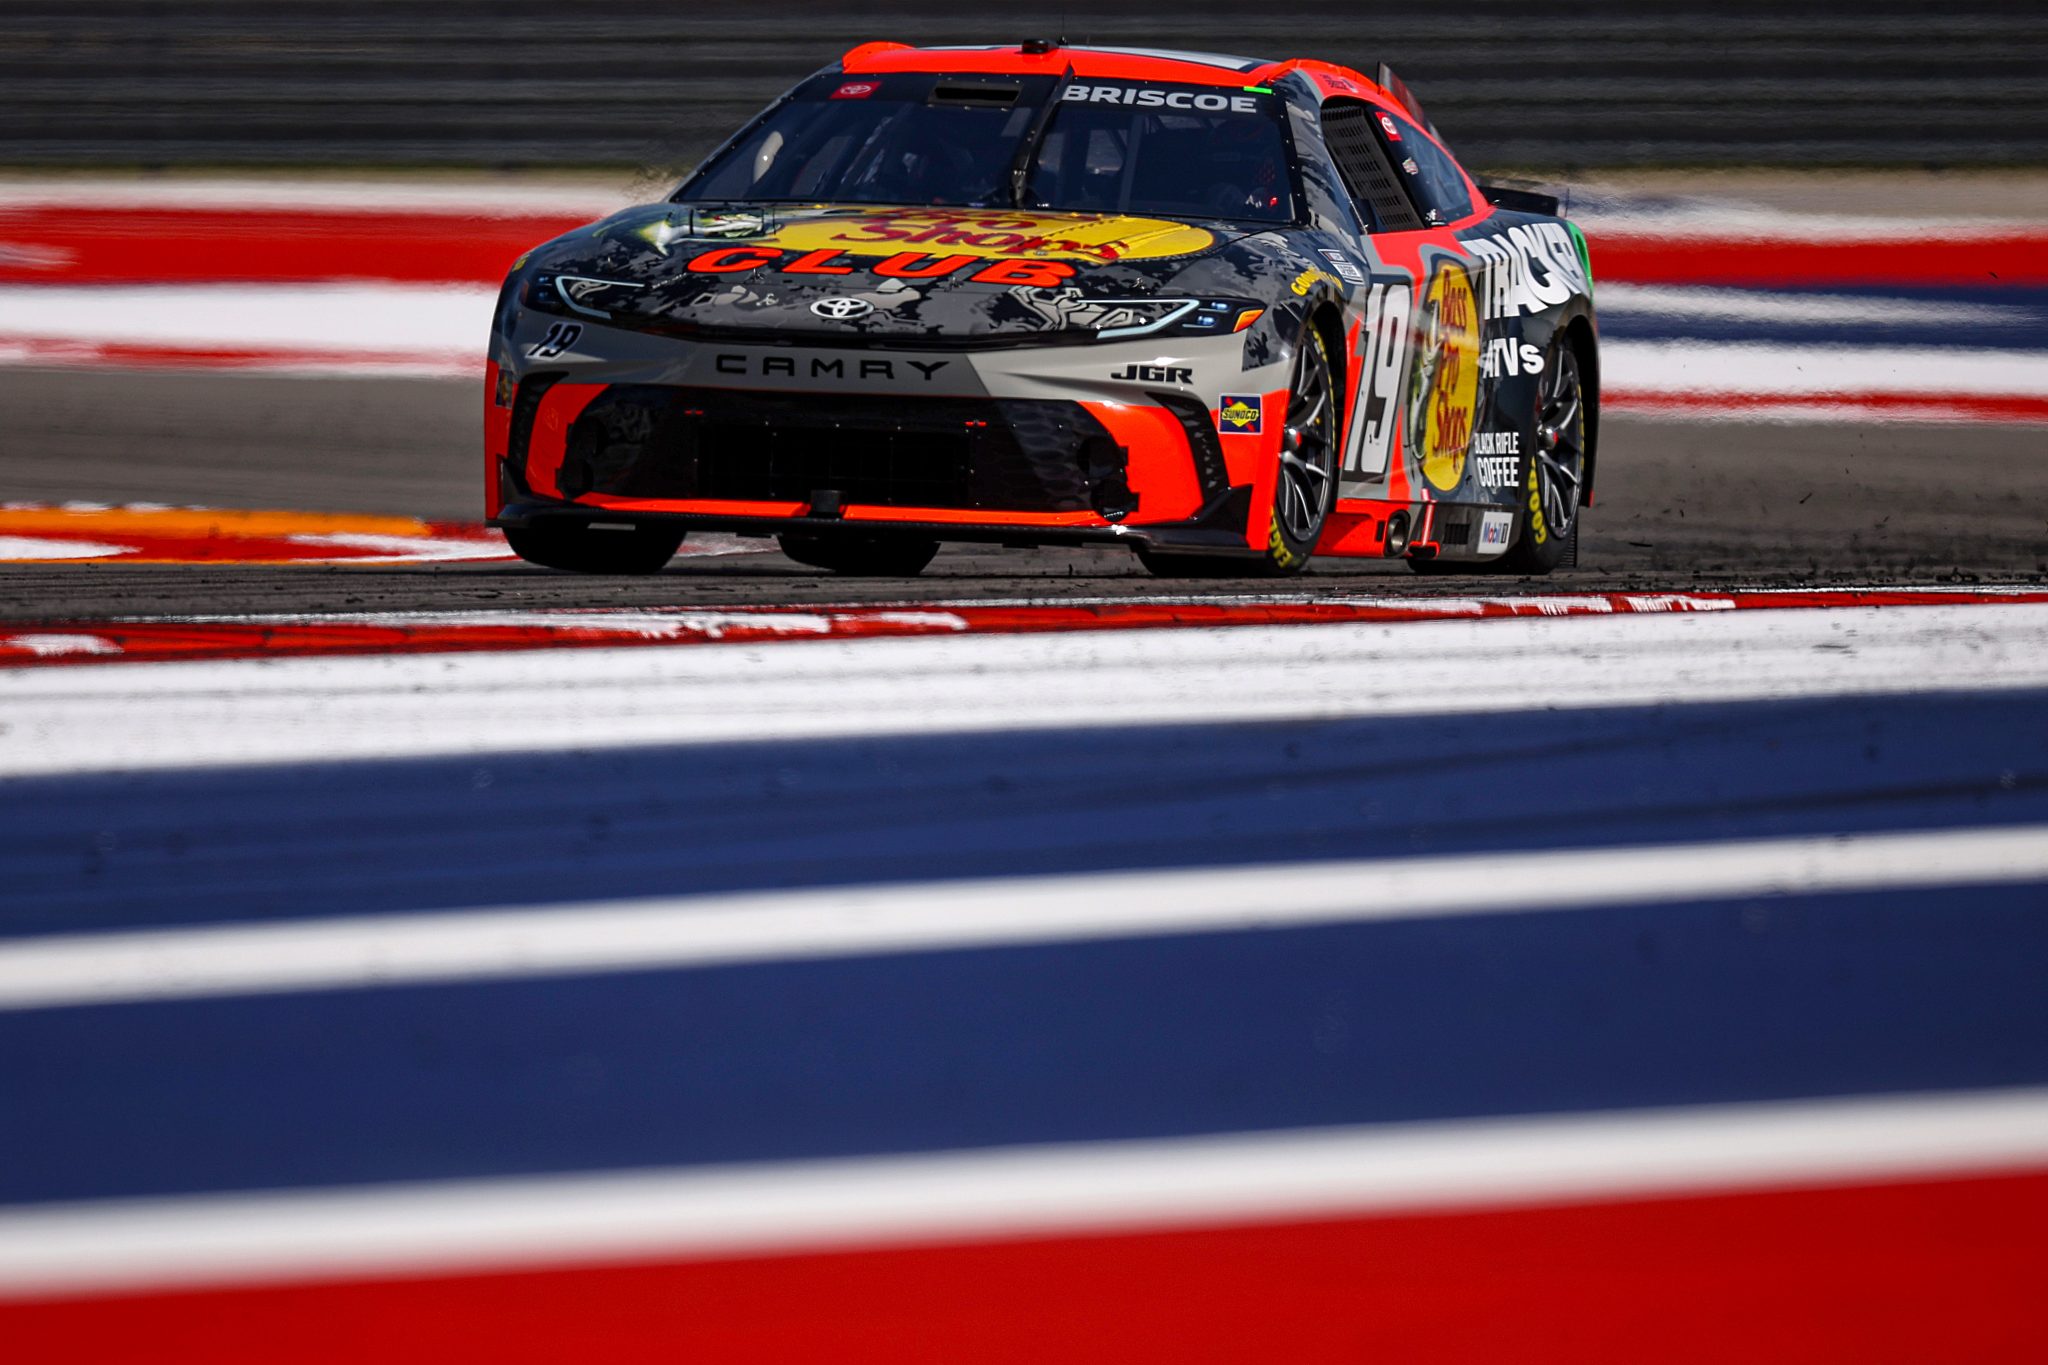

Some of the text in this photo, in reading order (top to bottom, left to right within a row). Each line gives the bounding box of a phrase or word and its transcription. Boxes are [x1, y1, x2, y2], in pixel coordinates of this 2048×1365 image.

[1062, 85, 1257, 113] BRISCOE
[686, 247, 1078, 287] CLUB
[1459, 222, 1590, 320] TRACKER
[526, 322, 583, 360] 19
[716, 354, 950, 381] CAMRY
[1482, 337, 1545, 379] ATVs
[1111, 365, 1193, 385] JGR
[1344, 283, 1411, 474] 19
[1222, 408, 1257, 420] SUNOCO
[1474, 432, 1520, 454] BLACK RIFLE
[1477, 457, 1520, 487] COFFEE
